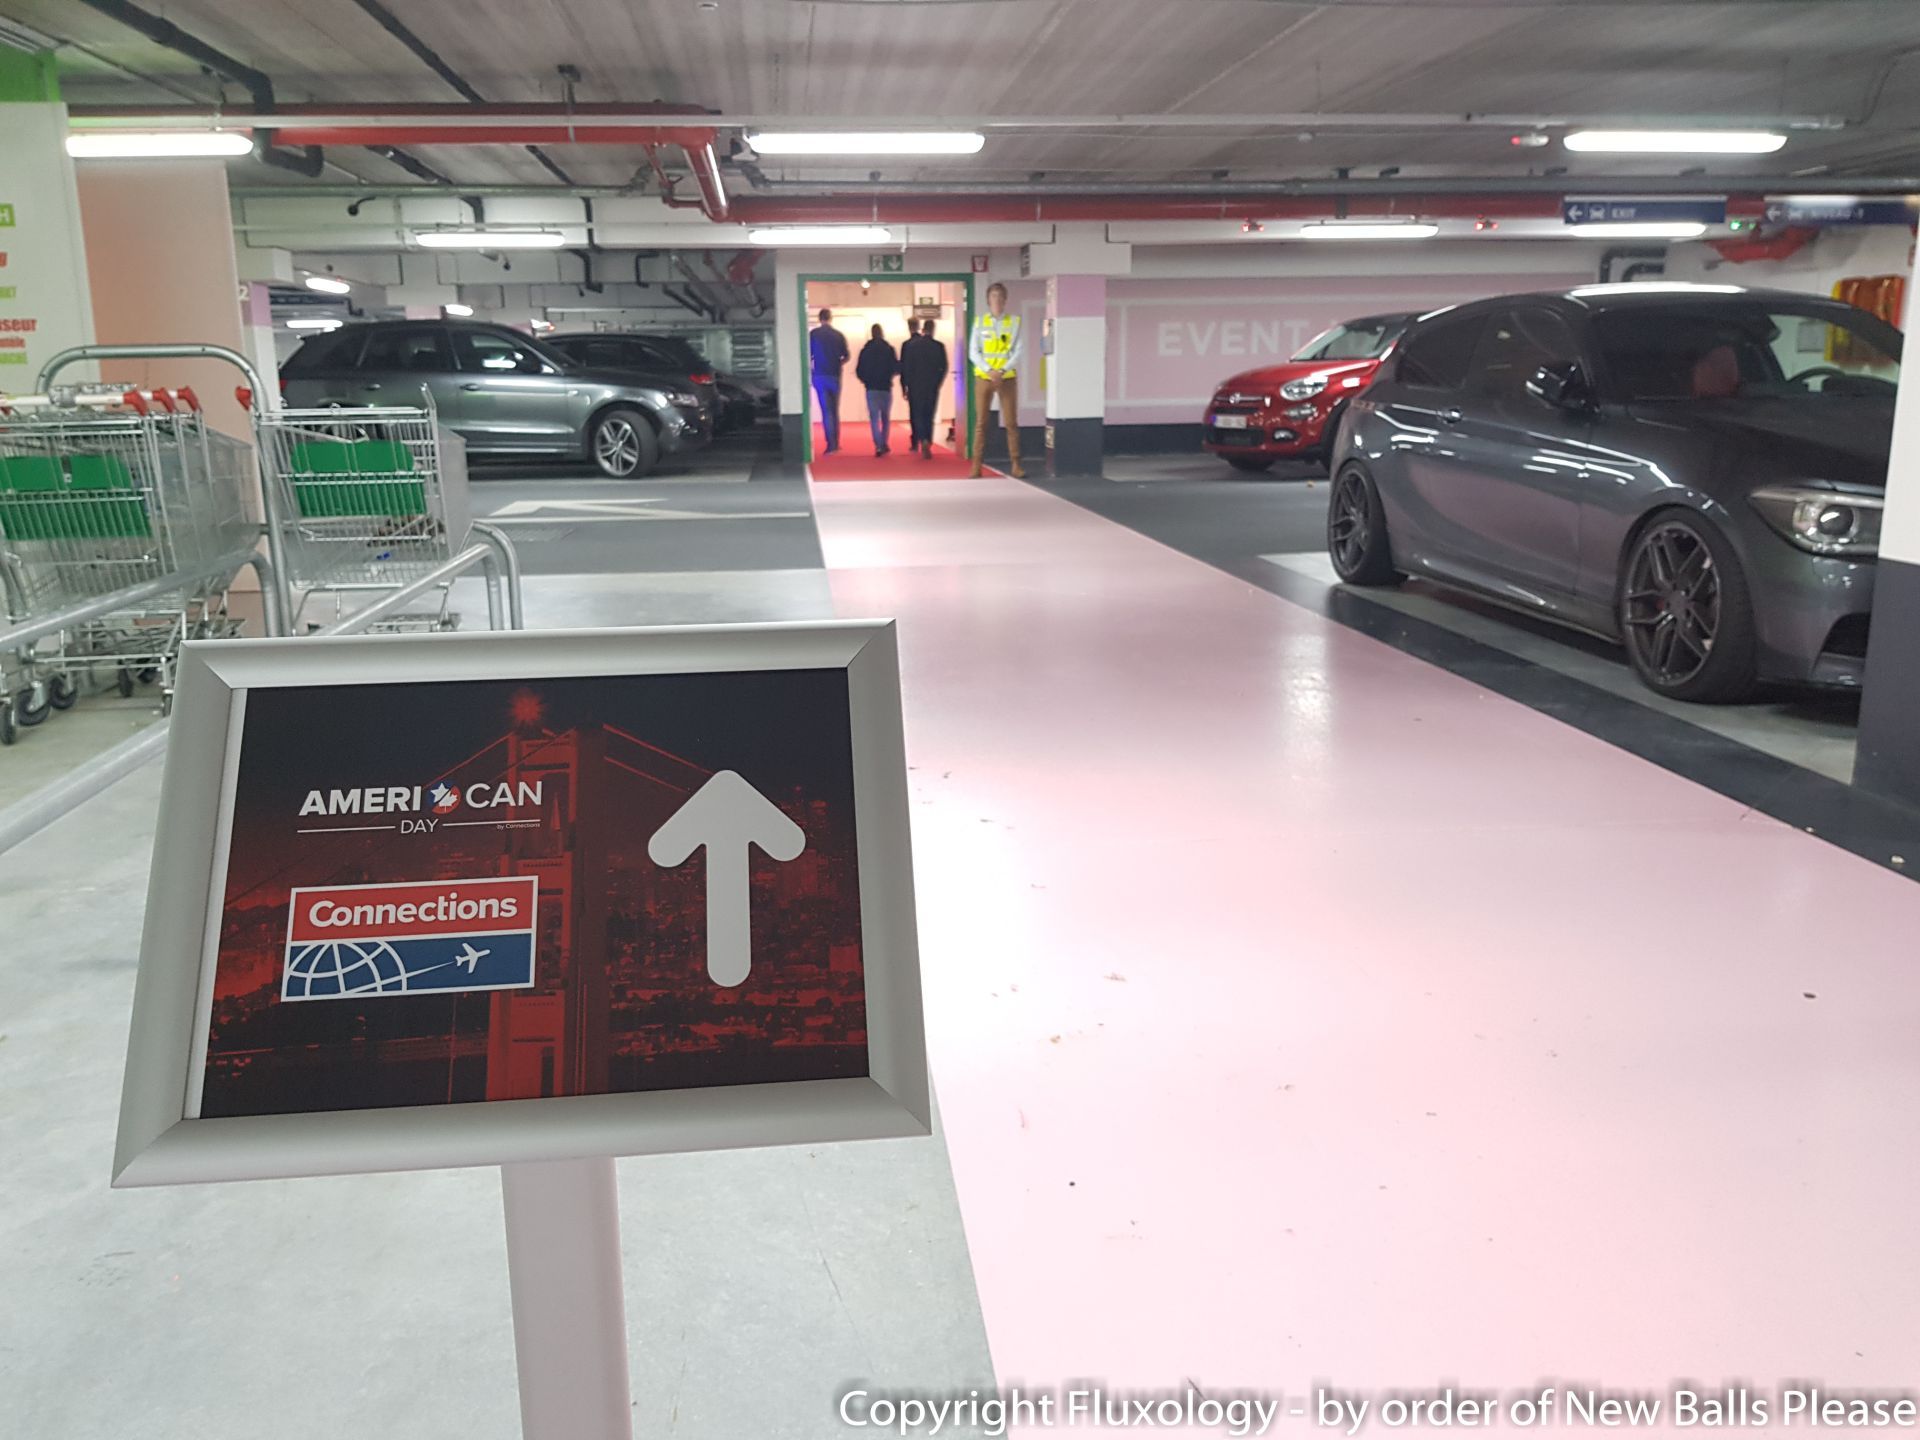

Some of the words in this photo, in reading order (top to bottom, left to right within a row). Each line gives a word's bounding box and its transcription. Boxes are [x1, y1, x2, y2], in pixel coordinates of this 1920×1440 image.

[1612, 207, 1636, 219] EXIT
[1157, 320, 1309, 357] EVENT
[299, 786, 422, 817] AMERI
[465, 781, 543, 809] CAN
[400, 818, 439, 835] DAY
[308, 892, 518, 928] Connections
